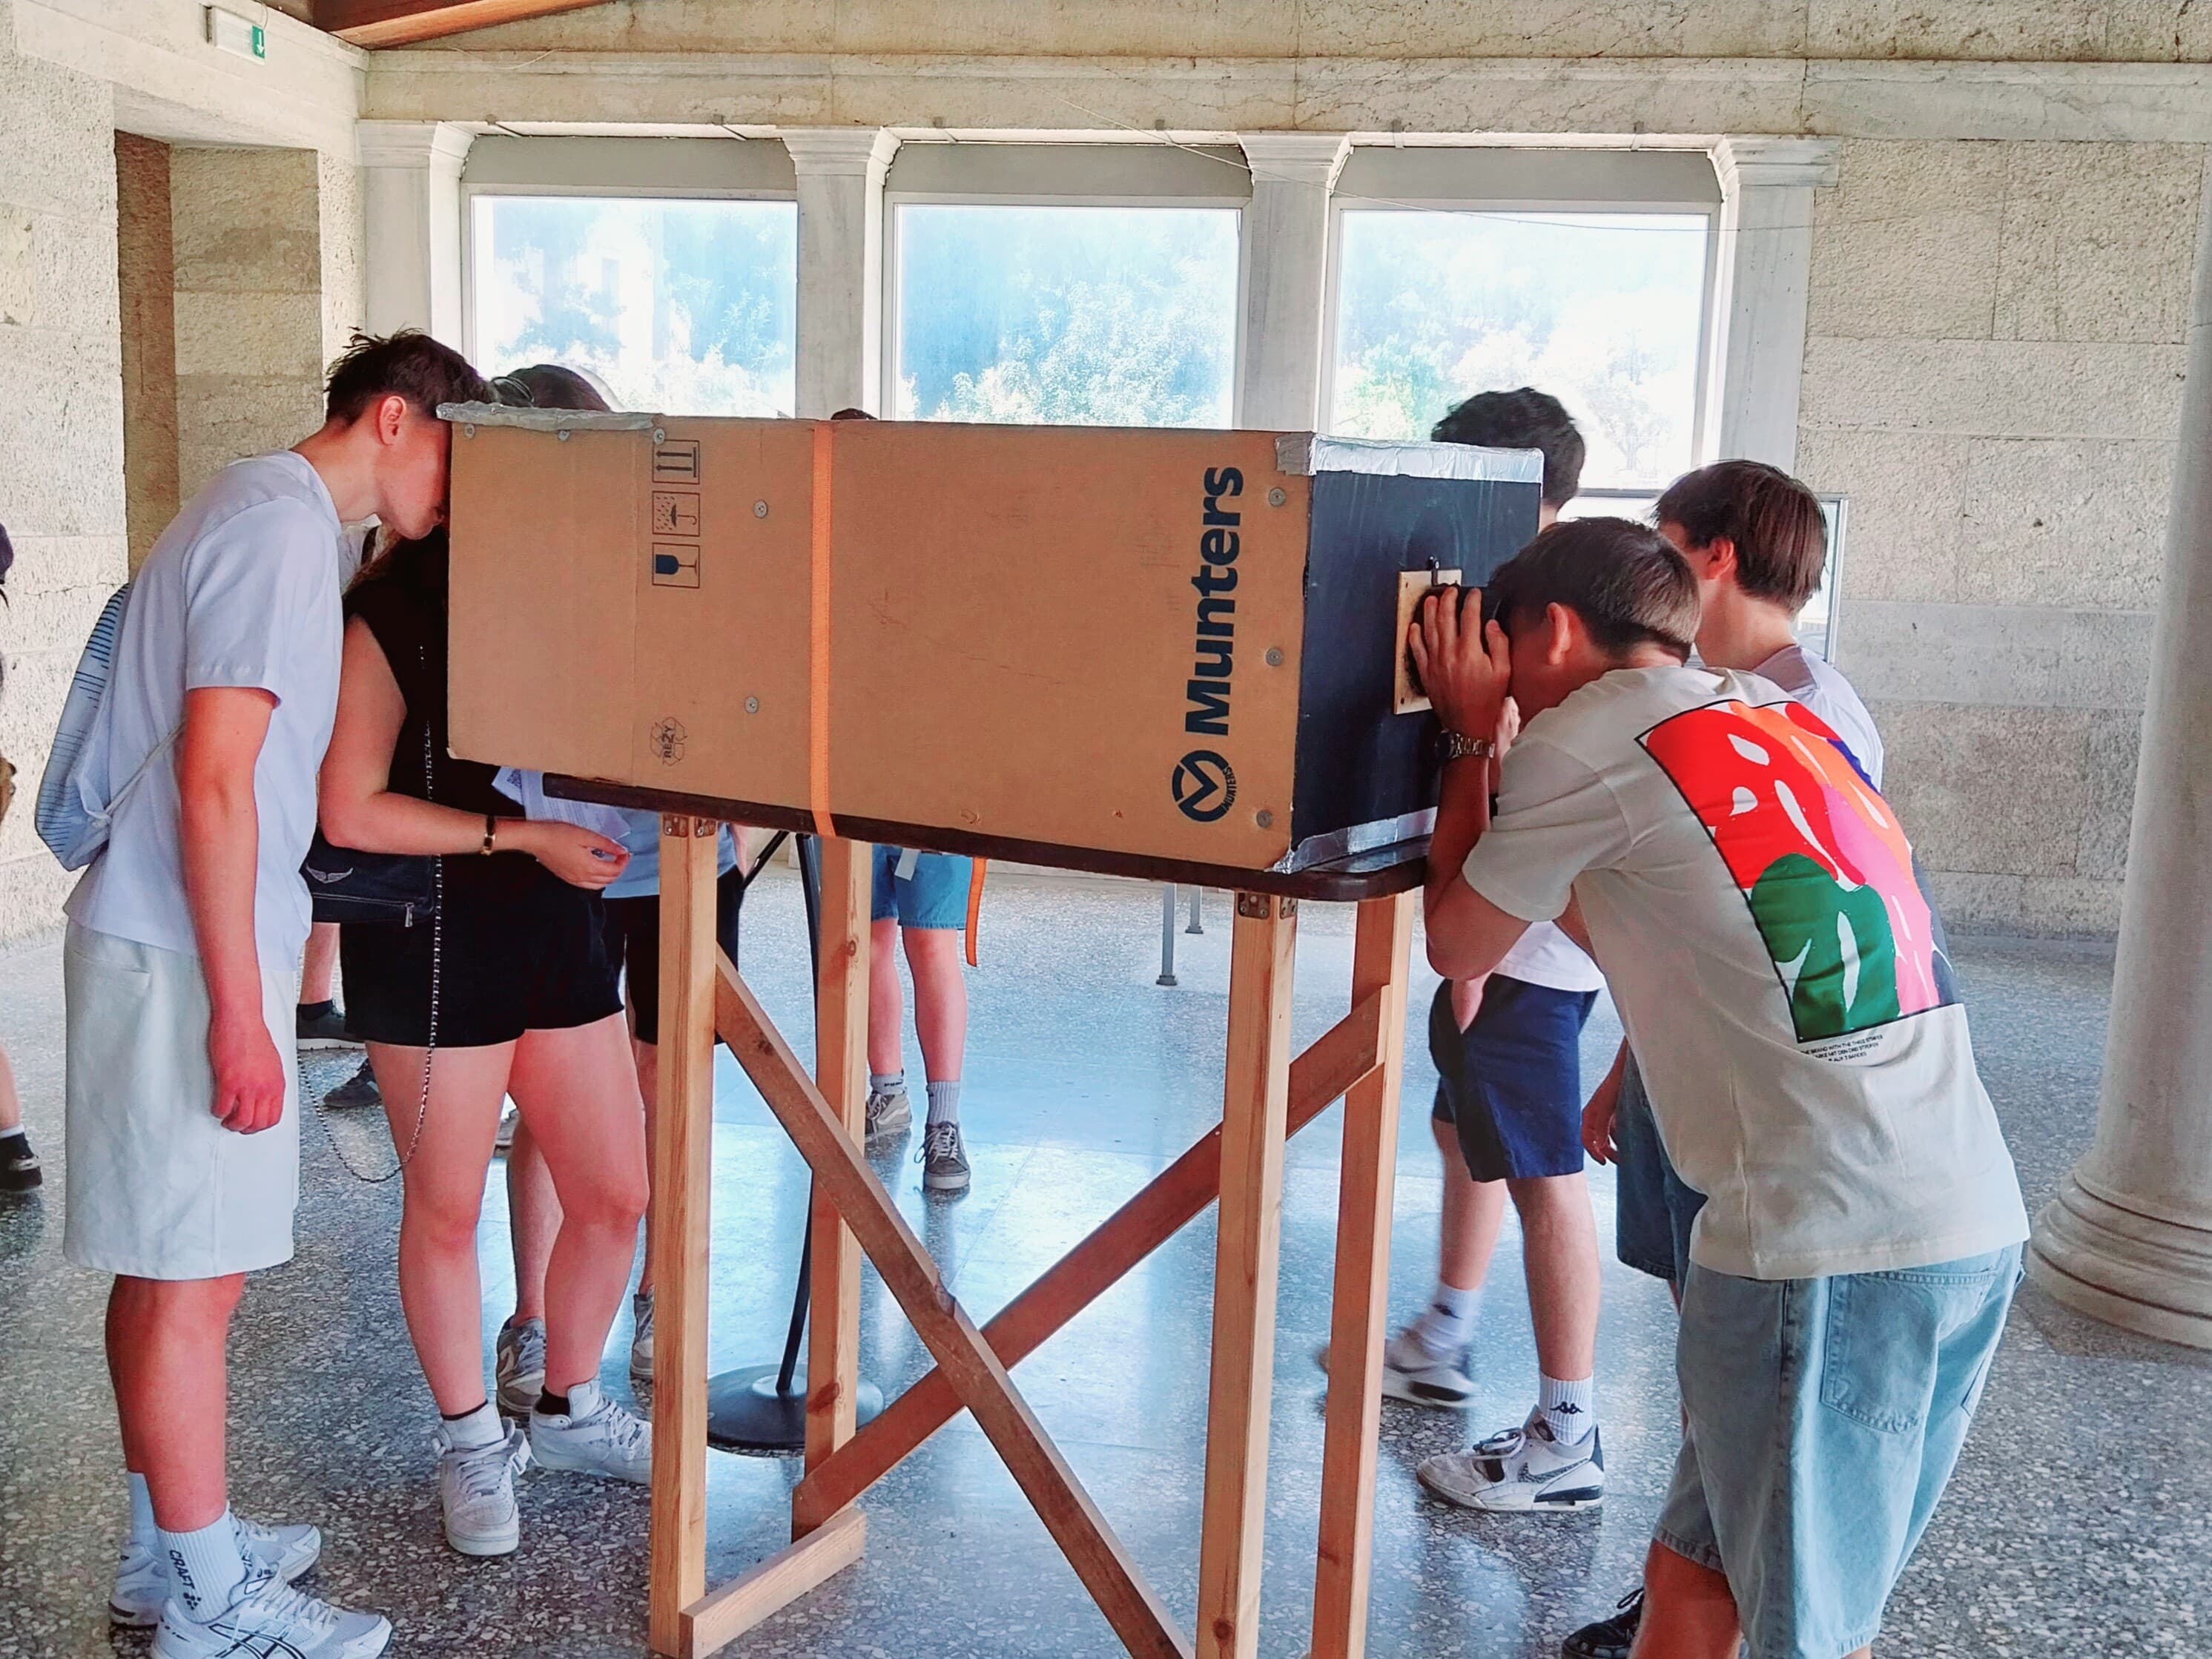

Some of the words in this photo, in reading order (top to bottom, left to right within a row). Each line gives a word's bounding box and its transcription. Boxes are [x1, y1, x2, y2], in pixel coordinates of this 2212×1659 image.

[1185, 466, 1244, 736] Munters
[1221, 766, 1237, 811] MUNTERS
[169, 1549, 196, 1590] CRAFT
